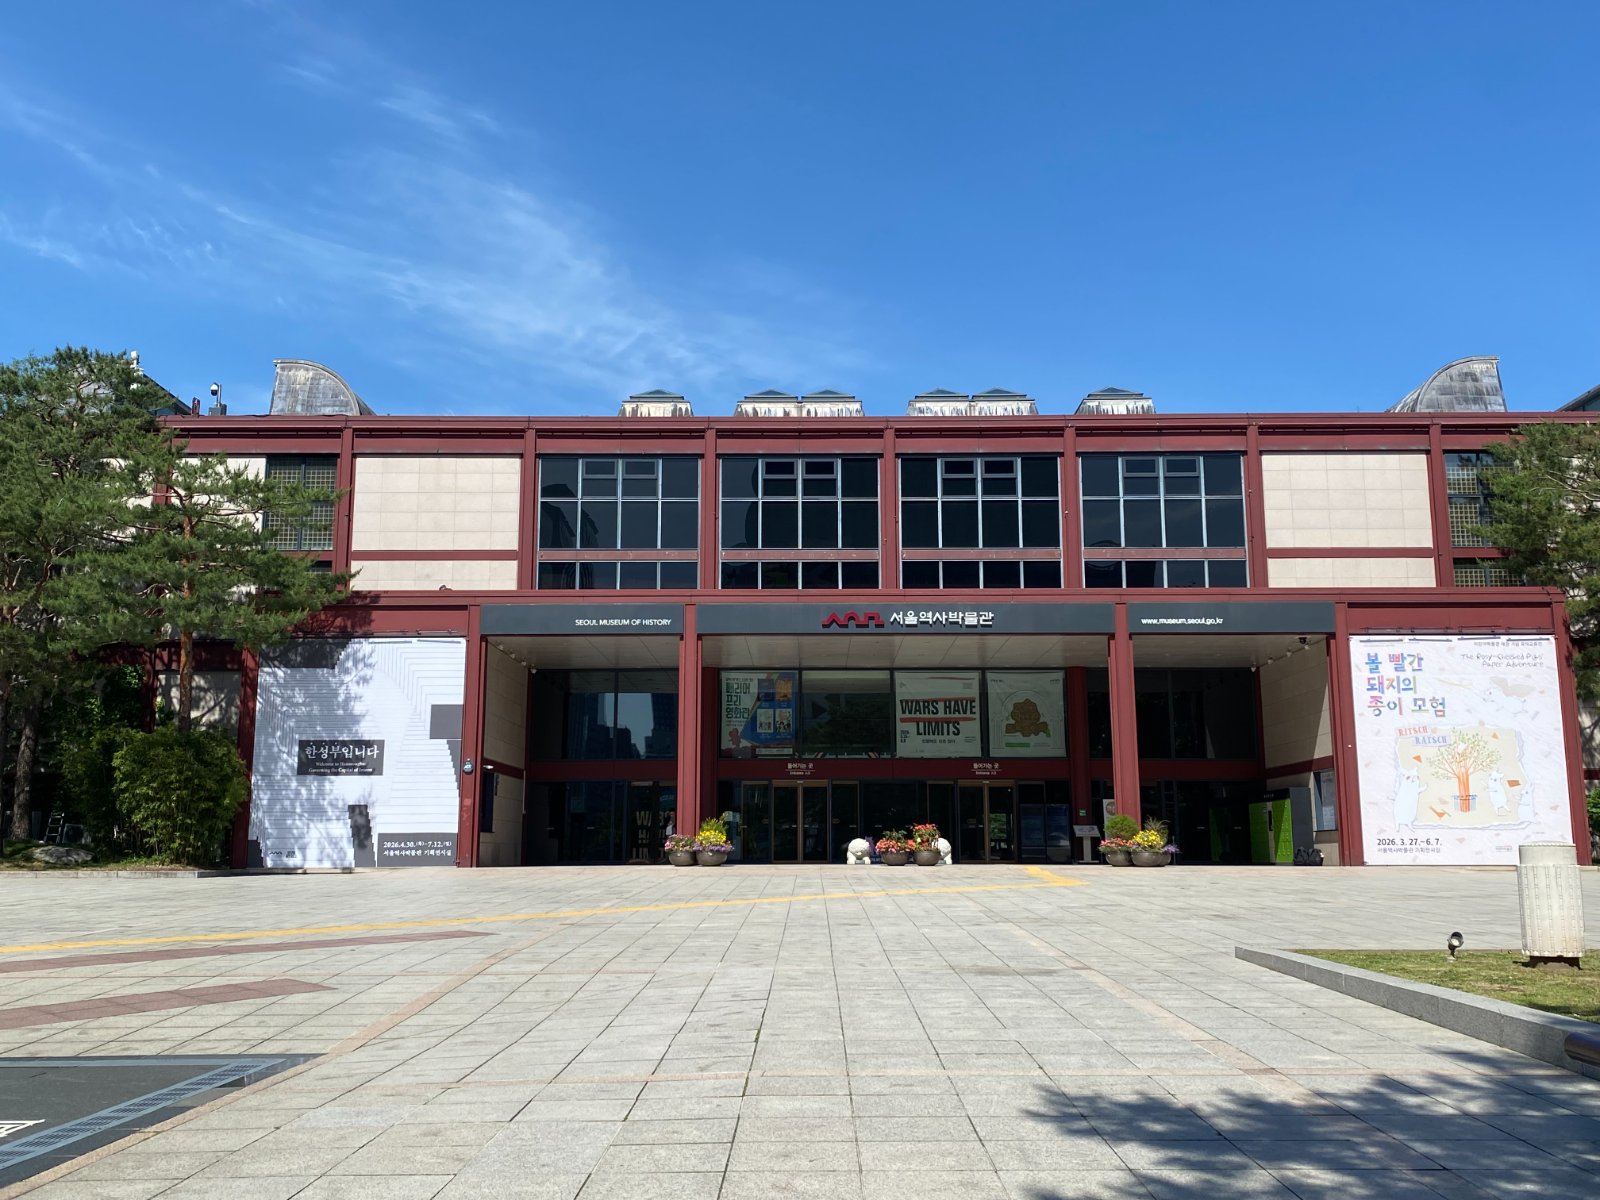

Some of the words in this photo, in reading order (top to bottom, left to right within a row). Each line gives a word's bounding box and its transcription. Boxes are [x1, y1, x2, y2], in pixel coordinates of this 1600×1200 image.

[890, 610, 994, 625] 서울역사박물관
[1141, 617, 1223, 625] www.museum.seoul.go.kr
[1365, 653, 1382, 674] 볼
[1388, 653, 1424, 672] 빨간
[1366, 675, 1417, 694] 돼지의
[726, 694, 741, 706] 프리
[900, 699, 939, 715] WARS
[944, 699, 976, 715] HAVE
[1367, 695, 1403, 717] 종이
[1411, 696, 1446, 717] 모험
[726, 707, 750, 720] 영화관
[916, 721, 961, 736] LIMITS
[1398, 725, 1428, 736] RITSCH
[1415, 736, 1447, 744] RATSCH
[305, 742, 380, 759] 한성부입니다
[1377, 838, 1398, 846] 2026.
[1400, 838, 1407, 846] 3.
[1435, 838, 1442, 846] 7.
